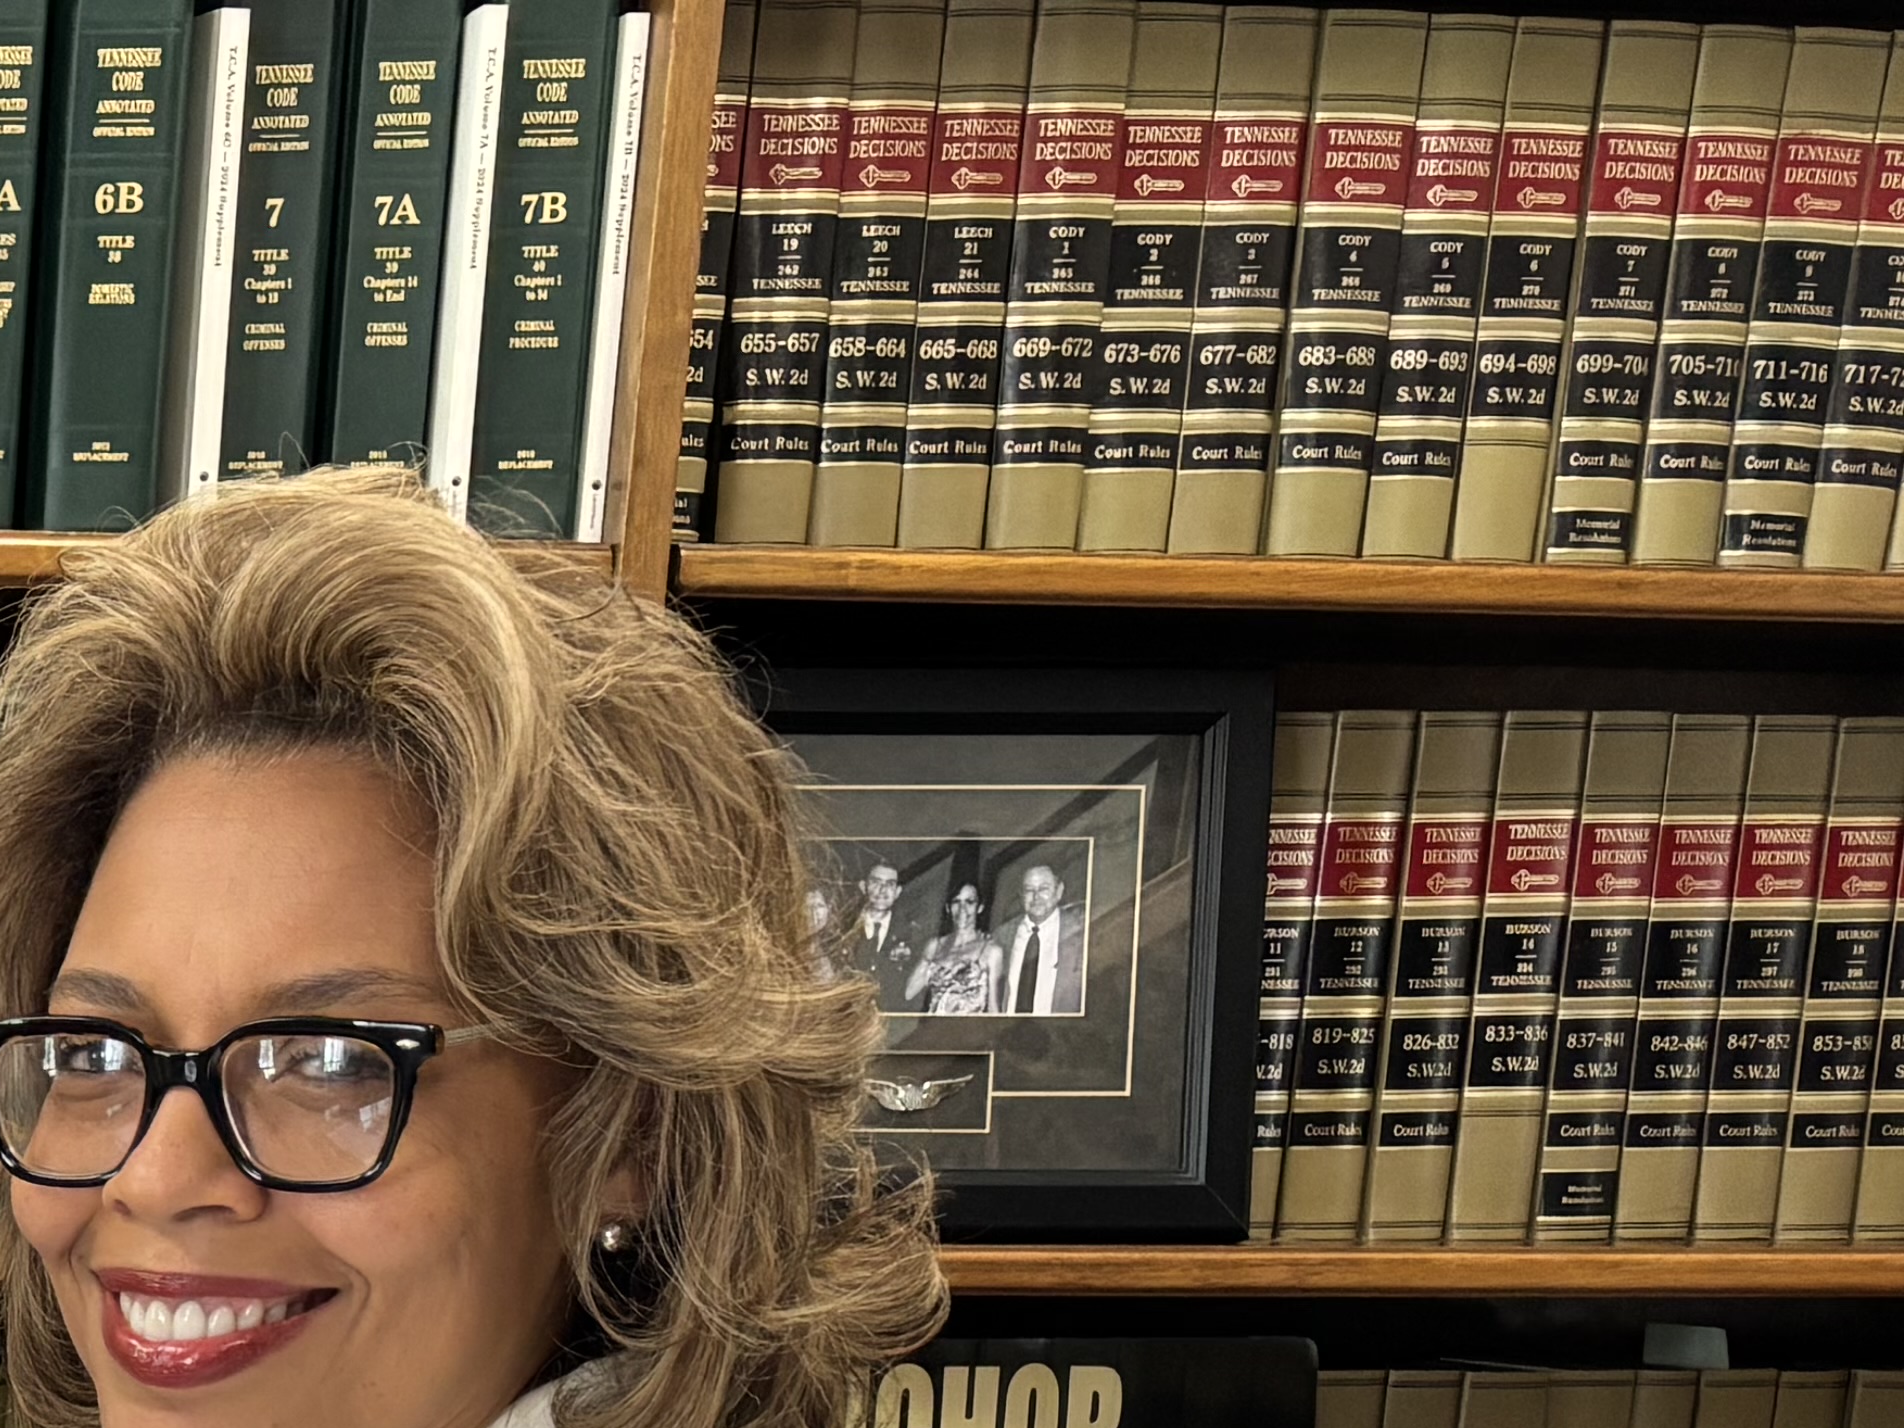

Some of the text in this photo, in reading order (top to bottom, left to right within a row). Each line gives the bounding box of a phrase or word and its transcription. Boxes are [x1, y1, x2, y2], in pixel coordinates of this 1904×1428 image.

[763, 113, 841, 133] TENNESSEE
[853, 116, 928, 135] TENNESSEE
[760, 136, 837, 157] DECISIONS
[850, 139, 926, 158] DECISIONS
[94, 182, 144, 214] 6B
[521, 192, 568, 224] 7B
[265, 198, 284, 227] 7
[375, 194, 420, 226] 7A
[782, 238, 798, 251] 19
[741, 332, 820, 355] 655-657
[829, 337, 906, 359] 658-664
[1013, 337, 1093, 359] 669-672
[1104, 344, 1181, 364] 673-676
[1200, 345, 1277, 366] 677-682
[1299, 346, 1375, 366] 683-688
[790, 368, 809, 386] 2d
[730, 436, 809, 452] Court Rules
